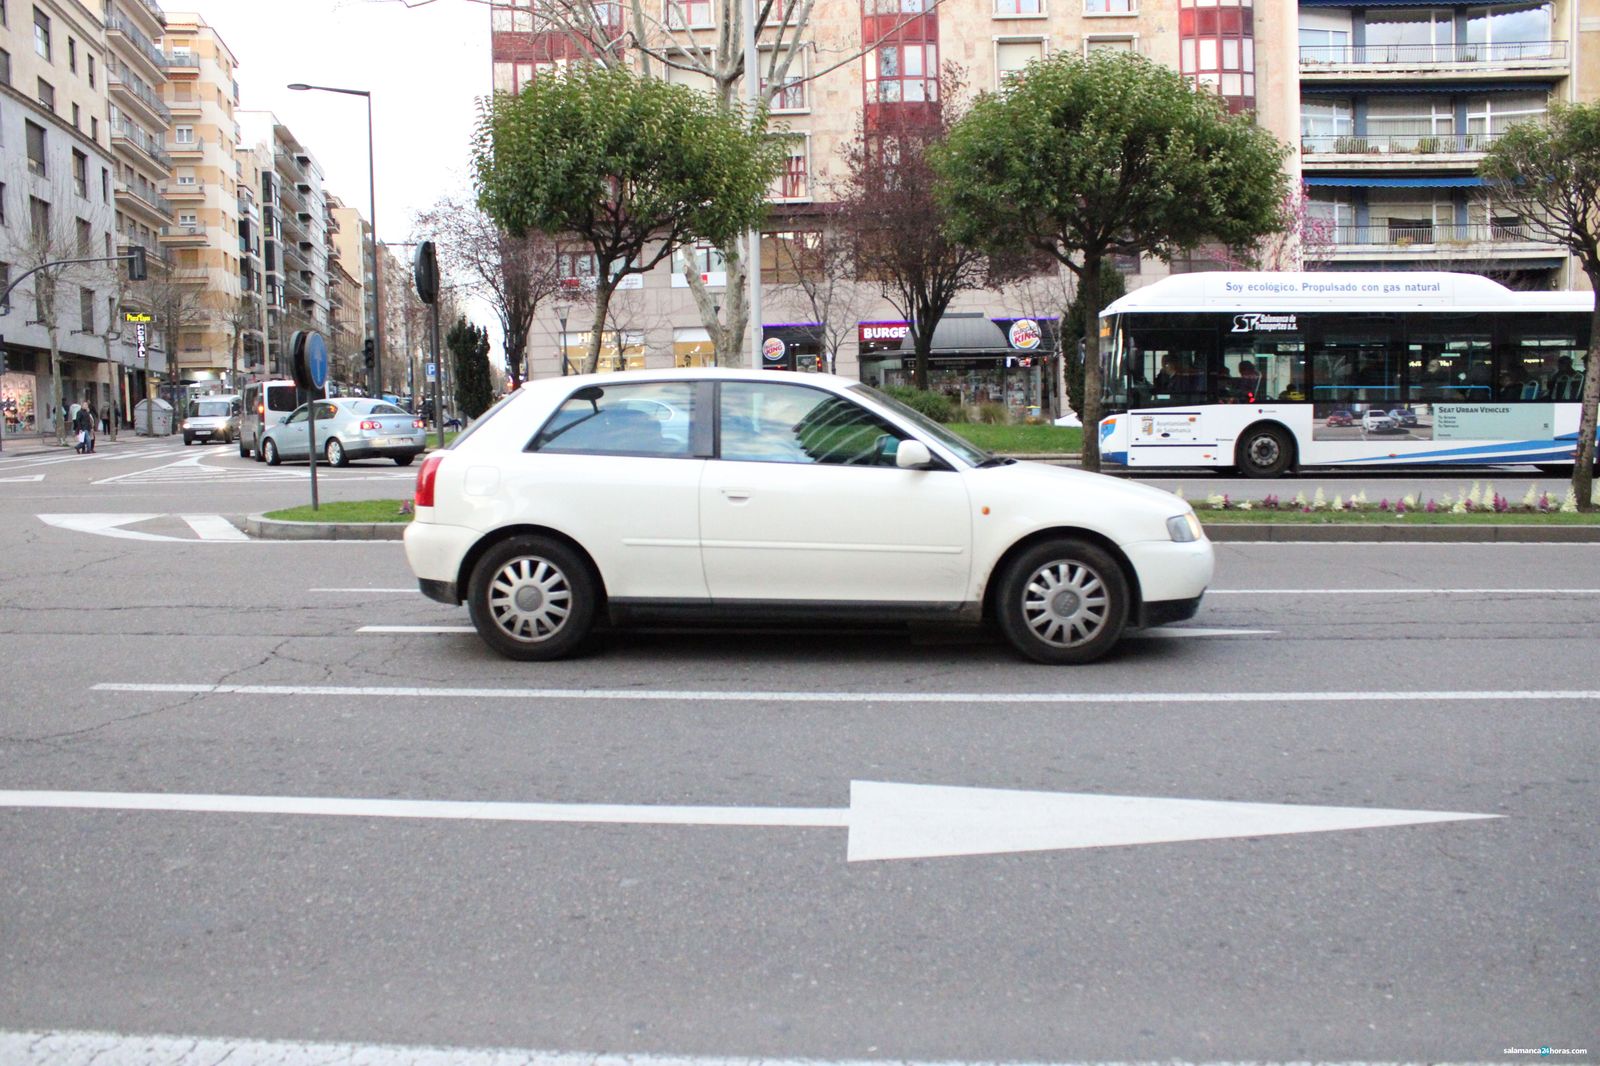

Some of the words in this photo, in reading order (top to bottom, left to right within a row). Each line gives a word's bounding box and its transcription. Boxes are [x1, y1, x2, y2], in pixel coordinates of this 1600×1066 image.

[1226, 282, 1243, 293] Soy
[1247, 281, 1298, 293] ecológico.
[1302, 282, 1358, 294] Propulsado
[1361, 284, 1380, 292] con
[1383, 284, 1401, 294] gas
[1405, 282, 1441, 292] natural
[863, 327, 909, 339] BURGE
[1014, 331, 1037, 344] KING
[137, 325, 146, 356] HOSTAL
[765, 345, 783, 355] KING
[428, 365, 435, 374] P
